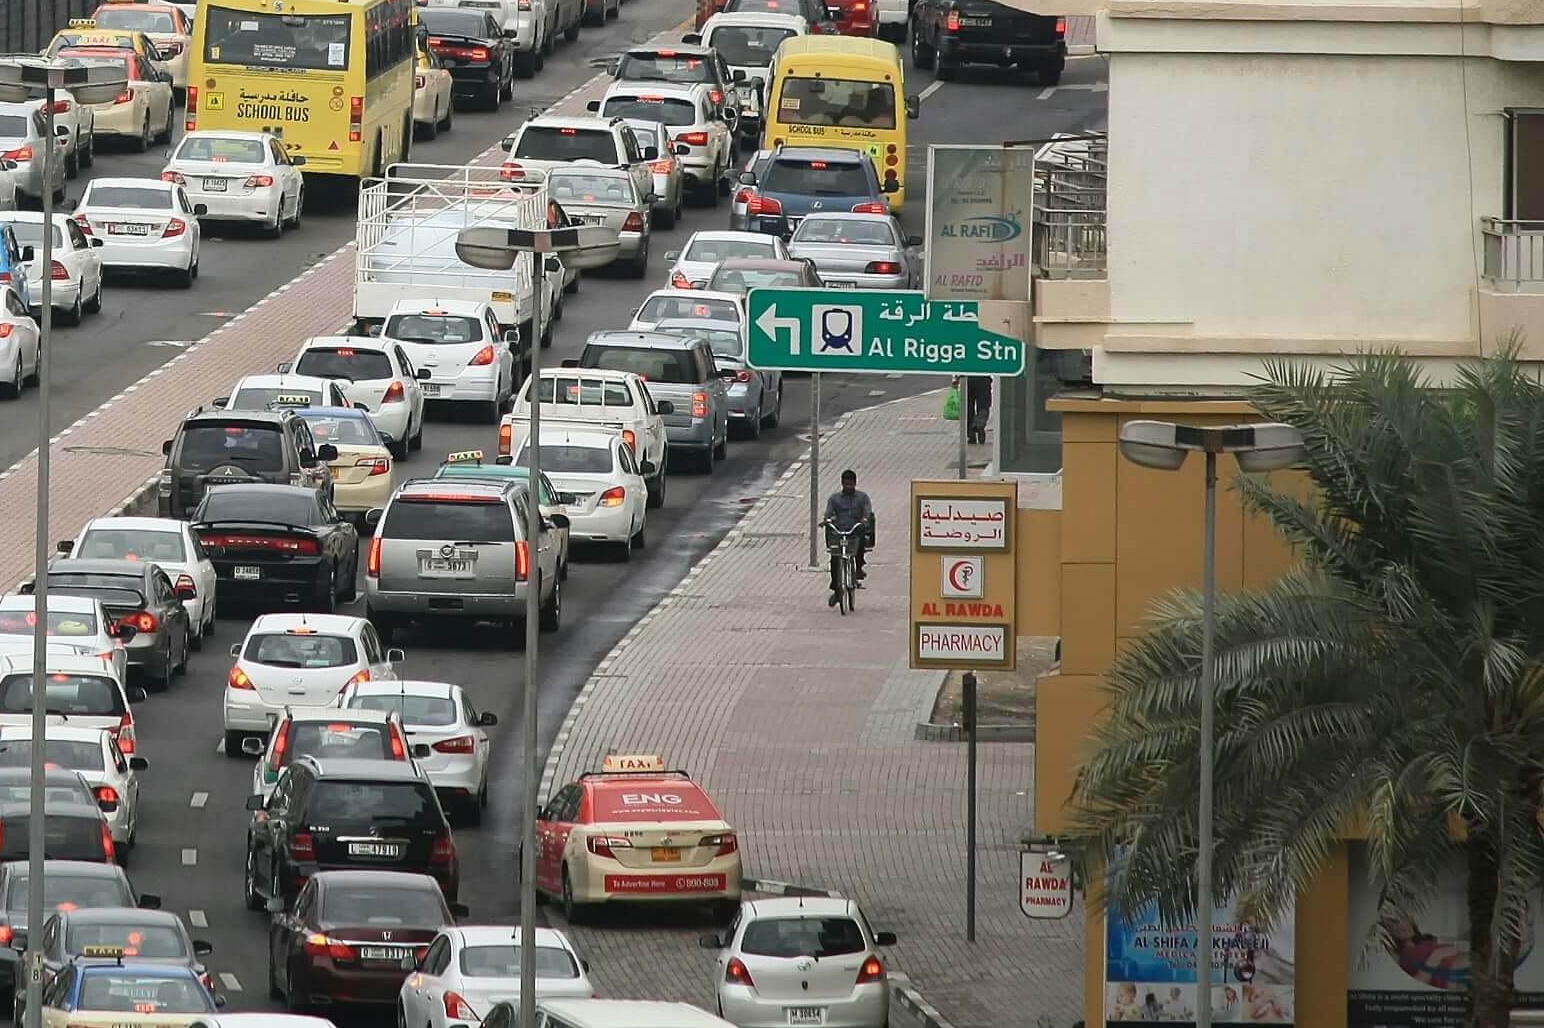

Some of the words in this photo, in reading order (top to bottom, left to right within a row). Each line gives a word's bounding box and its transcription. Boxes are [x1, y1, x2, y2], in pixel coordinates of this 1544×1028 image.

[239, 88, 278, 104] مدرسية
[279, 89, 309, 103] حافلة
[237, 102, 282, 120] SCHOOL
[285, 106, 309, 122] BUS
[788, 125, 812, 135] SCHOOL
[813, 127, 825, 136] BUS
[941, 225, 957, 237] AL
[936, 275, 947, 285] AL
[950, 275, 984, 286] RAFID
[880, 301, 931, 326] الرقة
[868, 337, 893, 357] Al
[904, 338, 966, 363] Rigga
[977, 340, 1017, 360] Stn
[922, 504, 1004, 525] صيدلية
[923, 526, 1002, 542] الروضة
[921, 602, 941, 617] AL
[945, 603, 1004, 618] RAWDA
[921, 633, 1002, 653] PHARMACY
[622, 793, 683, 806] ENG
[651, 880, 666, 888] Here
[1025, 877, 1067, 890] RAWDA
[1025, 896, 1067, 908] PHARMACY
[1134, 937, 1149, 949] AL
[1153, 936, 1189, 949] SHIFA
[1155, 950, 1197, 959] MEDICA
